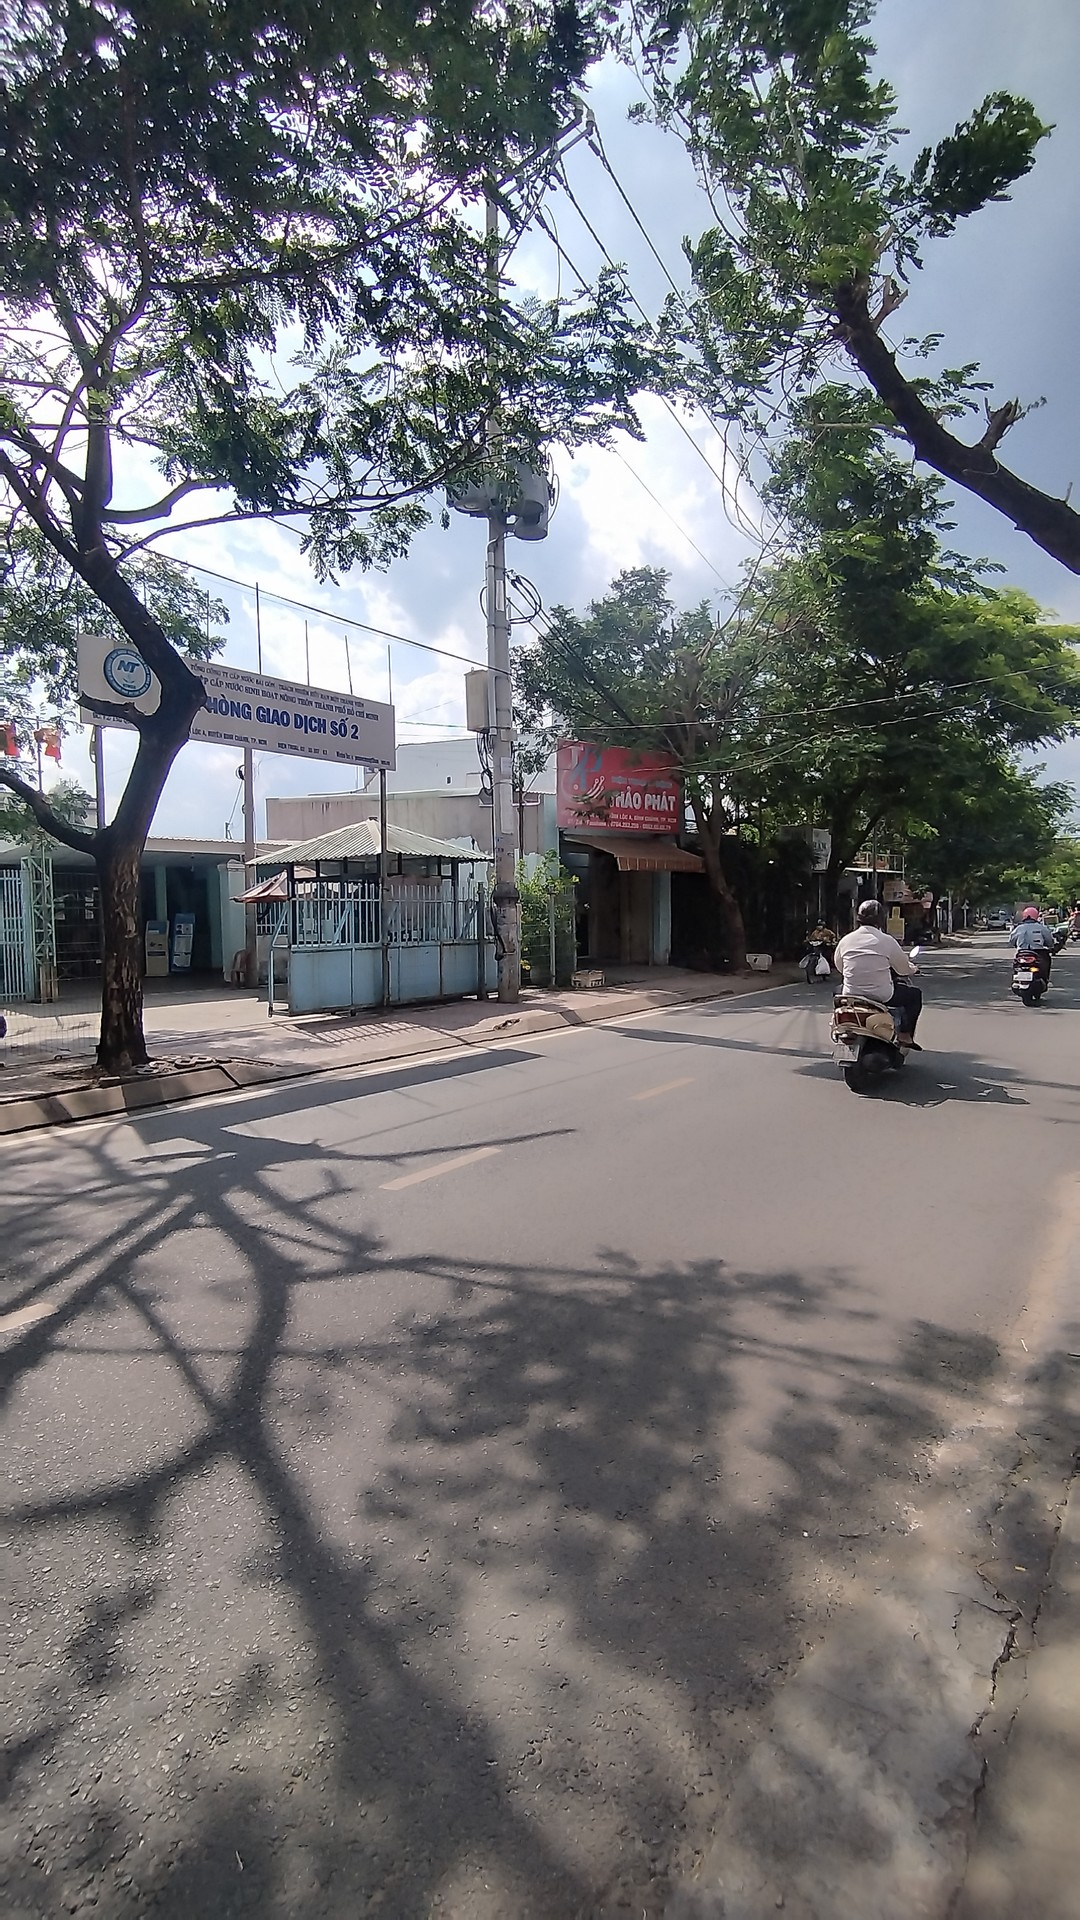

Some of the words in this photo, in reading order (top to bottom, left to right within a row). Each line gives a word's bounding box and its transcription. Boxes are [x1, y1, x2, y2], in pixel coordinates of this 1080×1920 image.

[117, 660, 140, 673] NT
[210, 678, 224, 688] CẤP
[245, 685, 261, 696] SINH
[206, 694, 252, 721] HÒNG
[256, 706, 291, 728] GIAO
[294, 713, 327, 734] DỊCH
[329, 717, 348, 738] SỐ
[350, 724, 360, 740] 2
[644, 791, 676, 812] PHÁT
